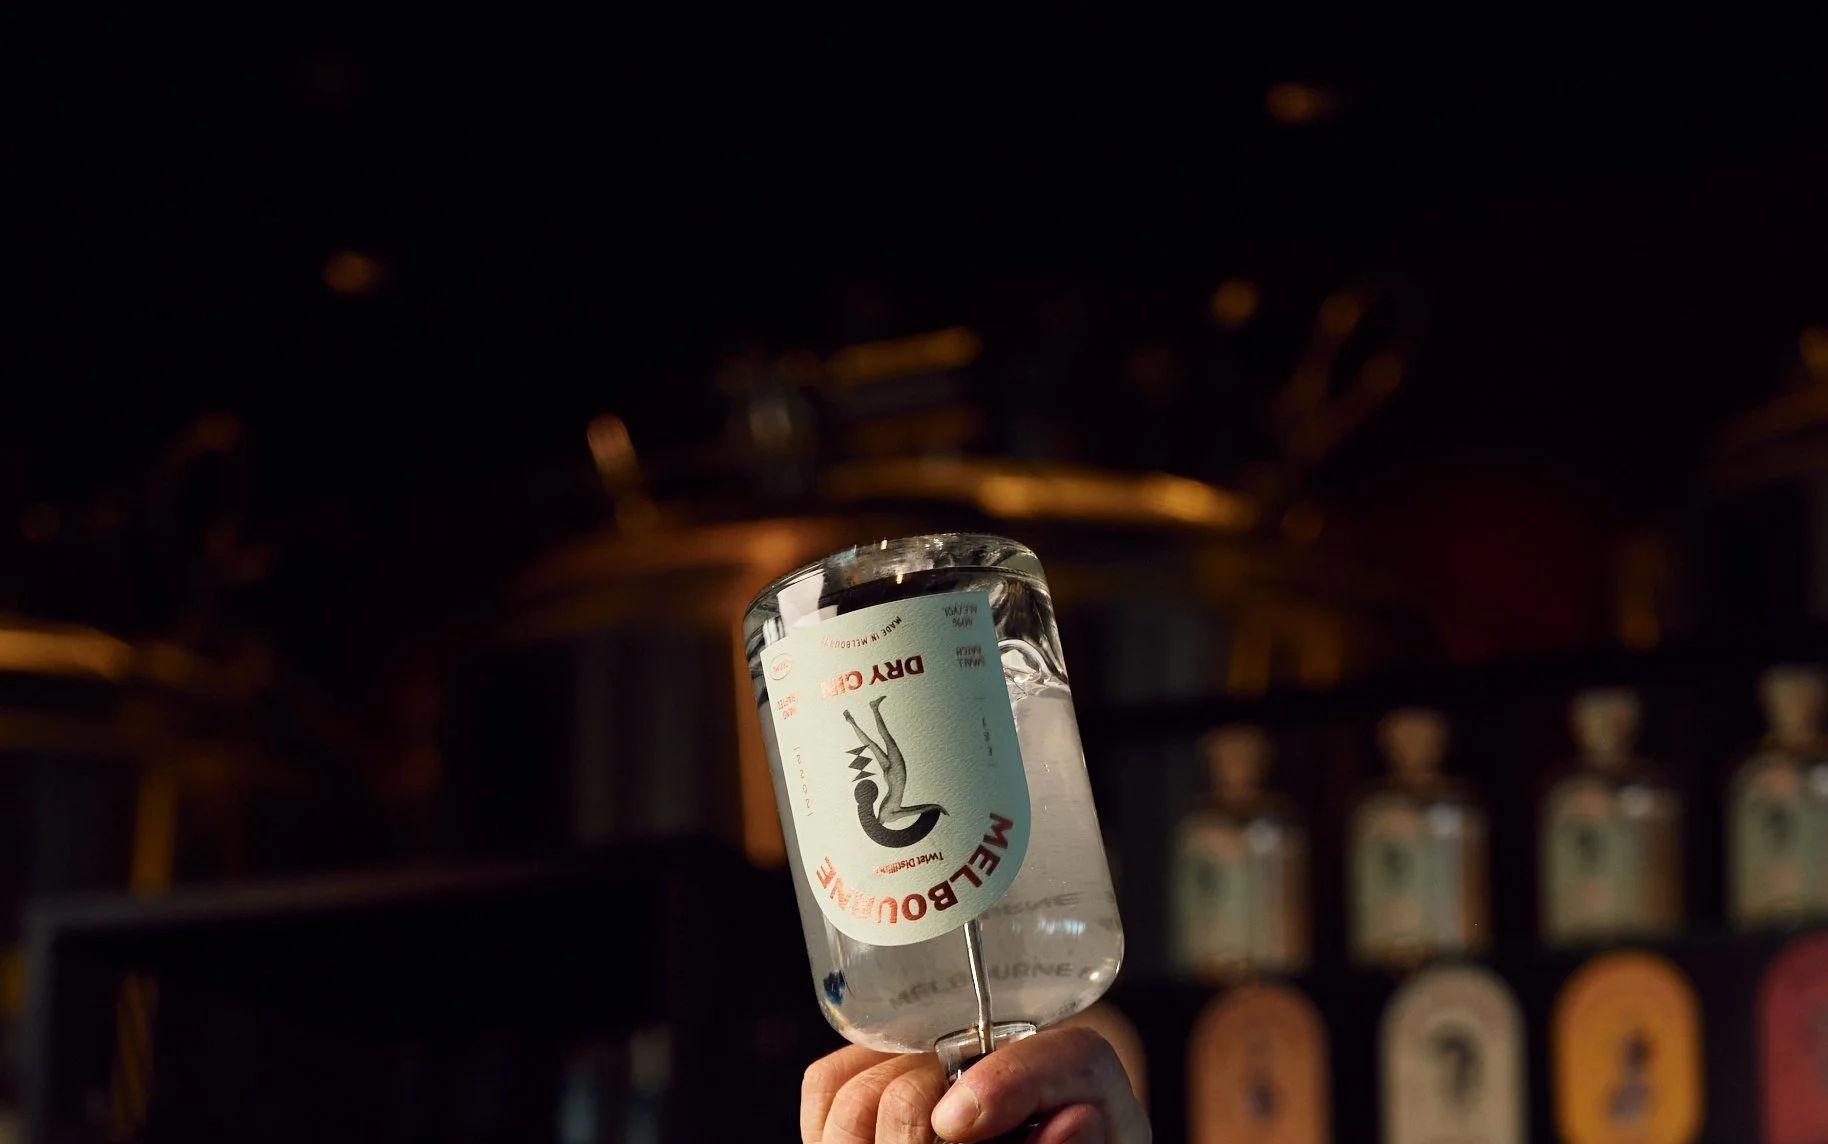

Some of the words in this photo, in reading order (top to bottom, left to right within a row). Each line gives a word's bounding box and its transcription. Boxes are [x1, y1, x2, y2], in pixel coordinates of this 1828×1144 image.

[871, 632, 880, 642] IN
[880, 616, 902, 637] MADE
[869, 655, 925, 686] DRY
[796, 754, 810, 809] 2022
[816, 812, 1014, 924] MELBOURNE
[917, 851, 944, 866] Twist
